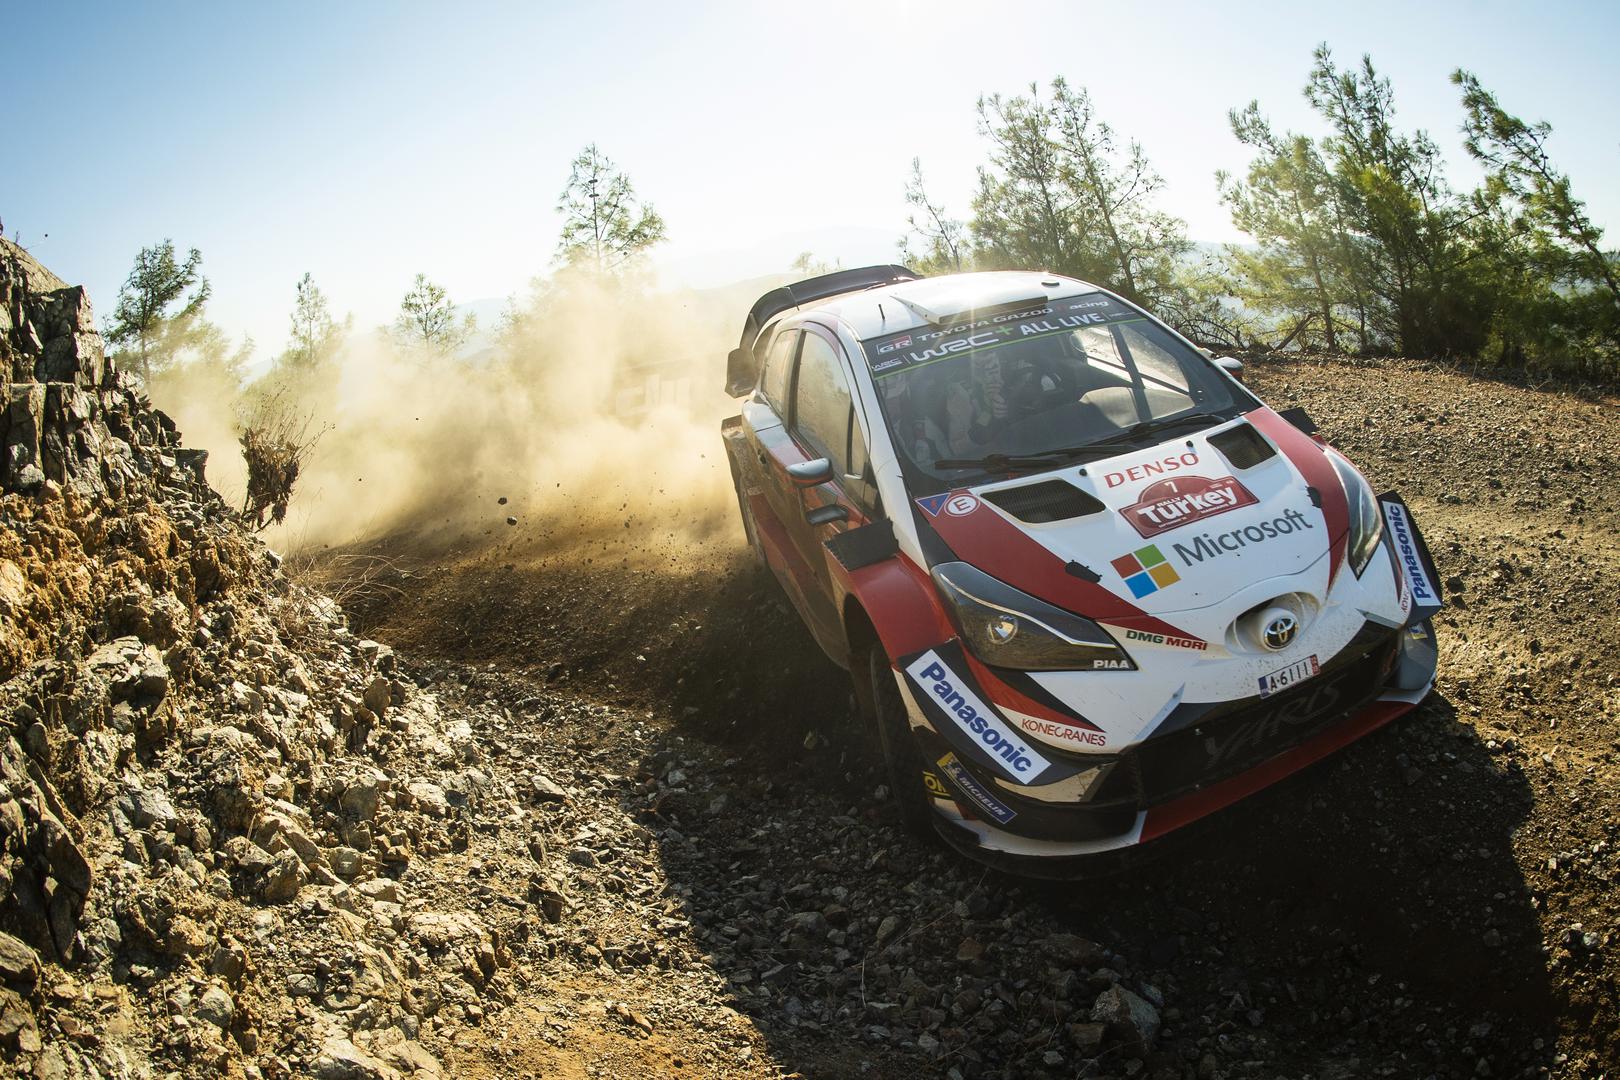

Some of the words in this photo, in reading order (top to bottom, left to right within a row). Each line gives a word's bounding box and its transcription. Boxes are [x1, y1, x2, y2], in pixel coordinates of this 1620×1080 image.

[916, 320, 990, 342] TOYOTA
[992, 308, 1054, 325] GAZOO
[1020, 320, 1060, 336] ALL
[1059, 312, 1105, 327] LIVE
[1104, 452, 1199, 488] DENSO
[1165, 481, 1178, 493] 7
[953, 498, 971, 511] E
[1136, 487, 1237, 523] Turkey
[1172, 508, 1313, 567] Microsoft
[1388, 505, 1432, 599] Panasonic
[1125, 629, 1164, 644] DMG
[1165, 636, 1208, 651] MORI
[1093, 659, 1130, 669] PIAA
[920, 661, 1032, 772] Panasonic
[1021, 718, 1107, 746] KONECRANES
[959, 777, 1006, 816] MICHELIN
